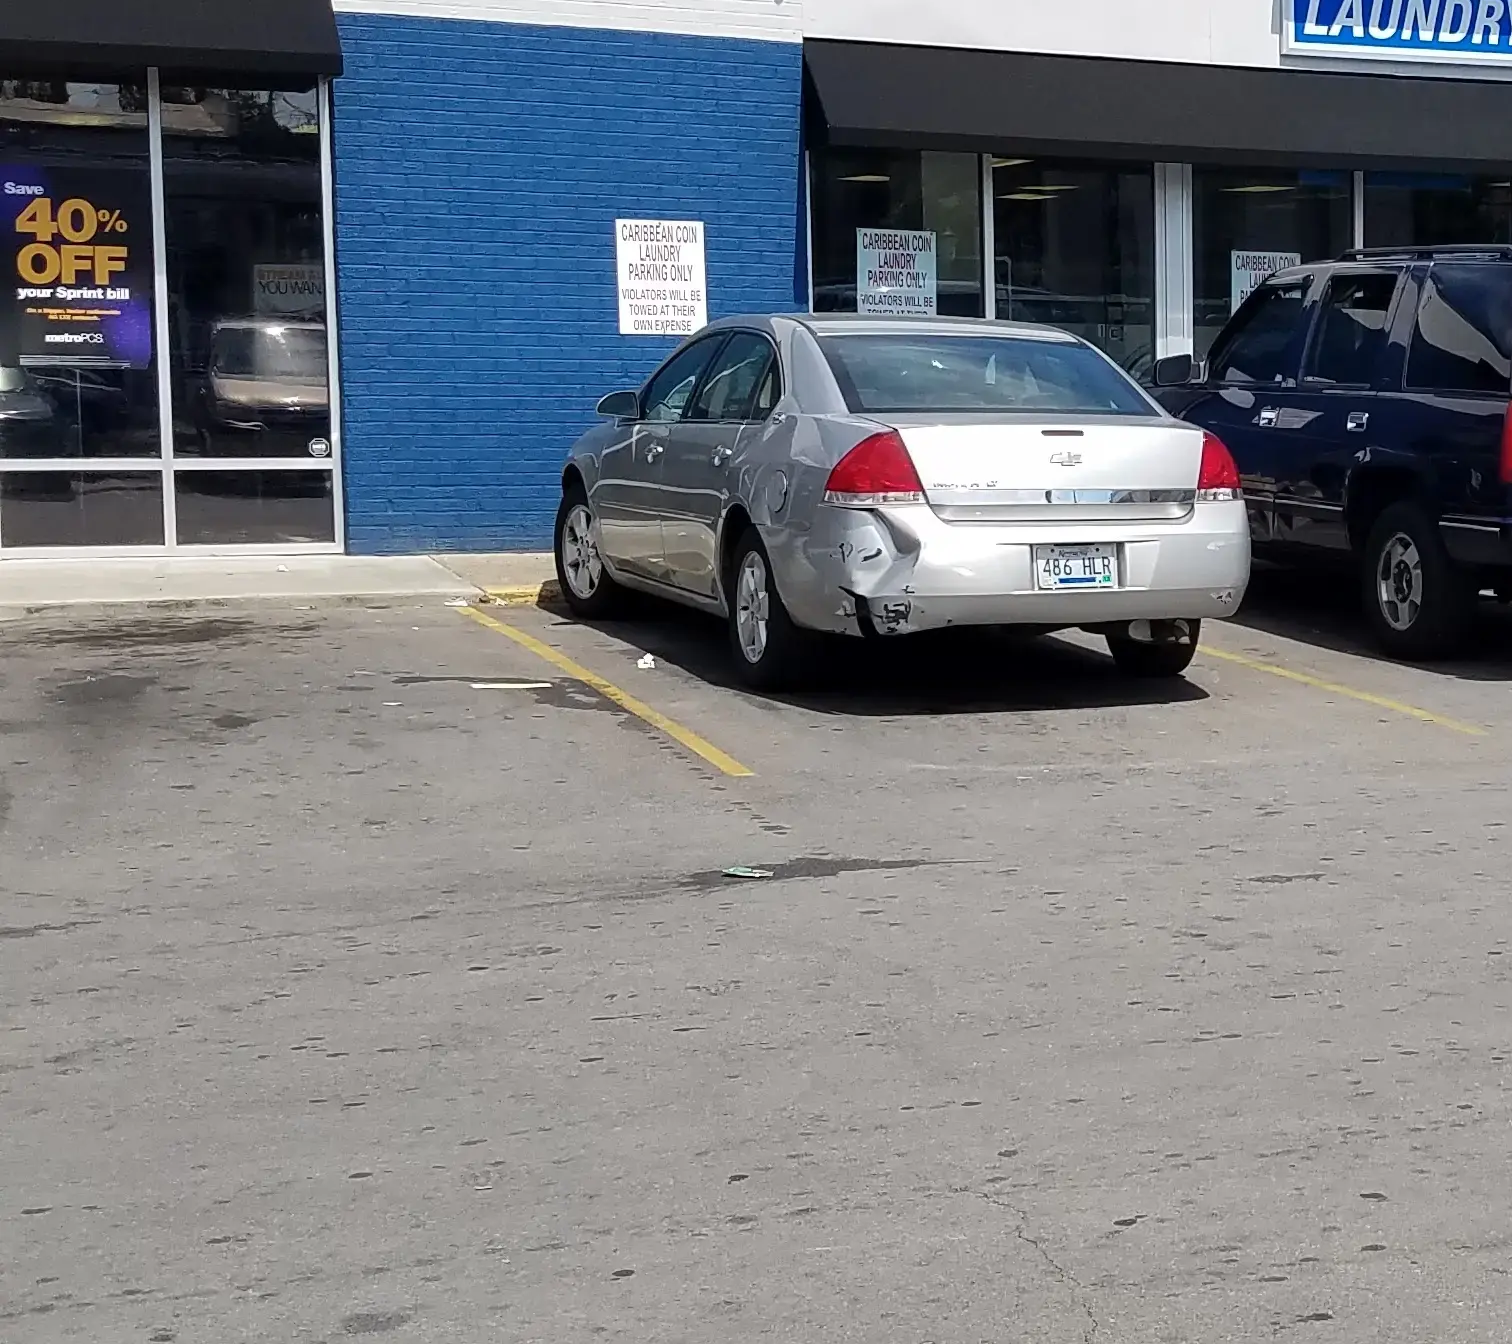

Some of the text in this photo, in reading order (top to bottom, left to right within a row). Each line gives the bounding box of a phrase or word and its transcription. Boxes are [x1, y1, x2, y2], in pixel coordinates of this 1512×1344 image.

[4, 181, 44, 195] Save
[15, 197, 128, 243] 40%
[621, 224, 697, 243] CARIBBEAN COIN
[862, 233, 932, 252] CARIBBEAN COIN
[639, 244, 681, 262] LAUNDRY
[878, 252, 917, 270] LAUNDRY
[17, 243, 128, 285] OFF
[629, 263, 693, 282] PARKING ONLY
[1236, 255, 1277, 272] CARIBBEAN
[258, 280, 288, 294] YOU
[867, 270, 927, 288] PARKING ONLY
[17, 286, 130, 300] your Sprint bill
[622, 288, 701, 301] VIOLATORS WILL BE
[861, 294, 933, 307] VIOLATORS WILL BE
[629, 304, 695, 316] TOWED AT THEIR
[633, 320, 692, 331] OWN EXPENSE
[1043, 556, 1111, 576] 486 HLR
